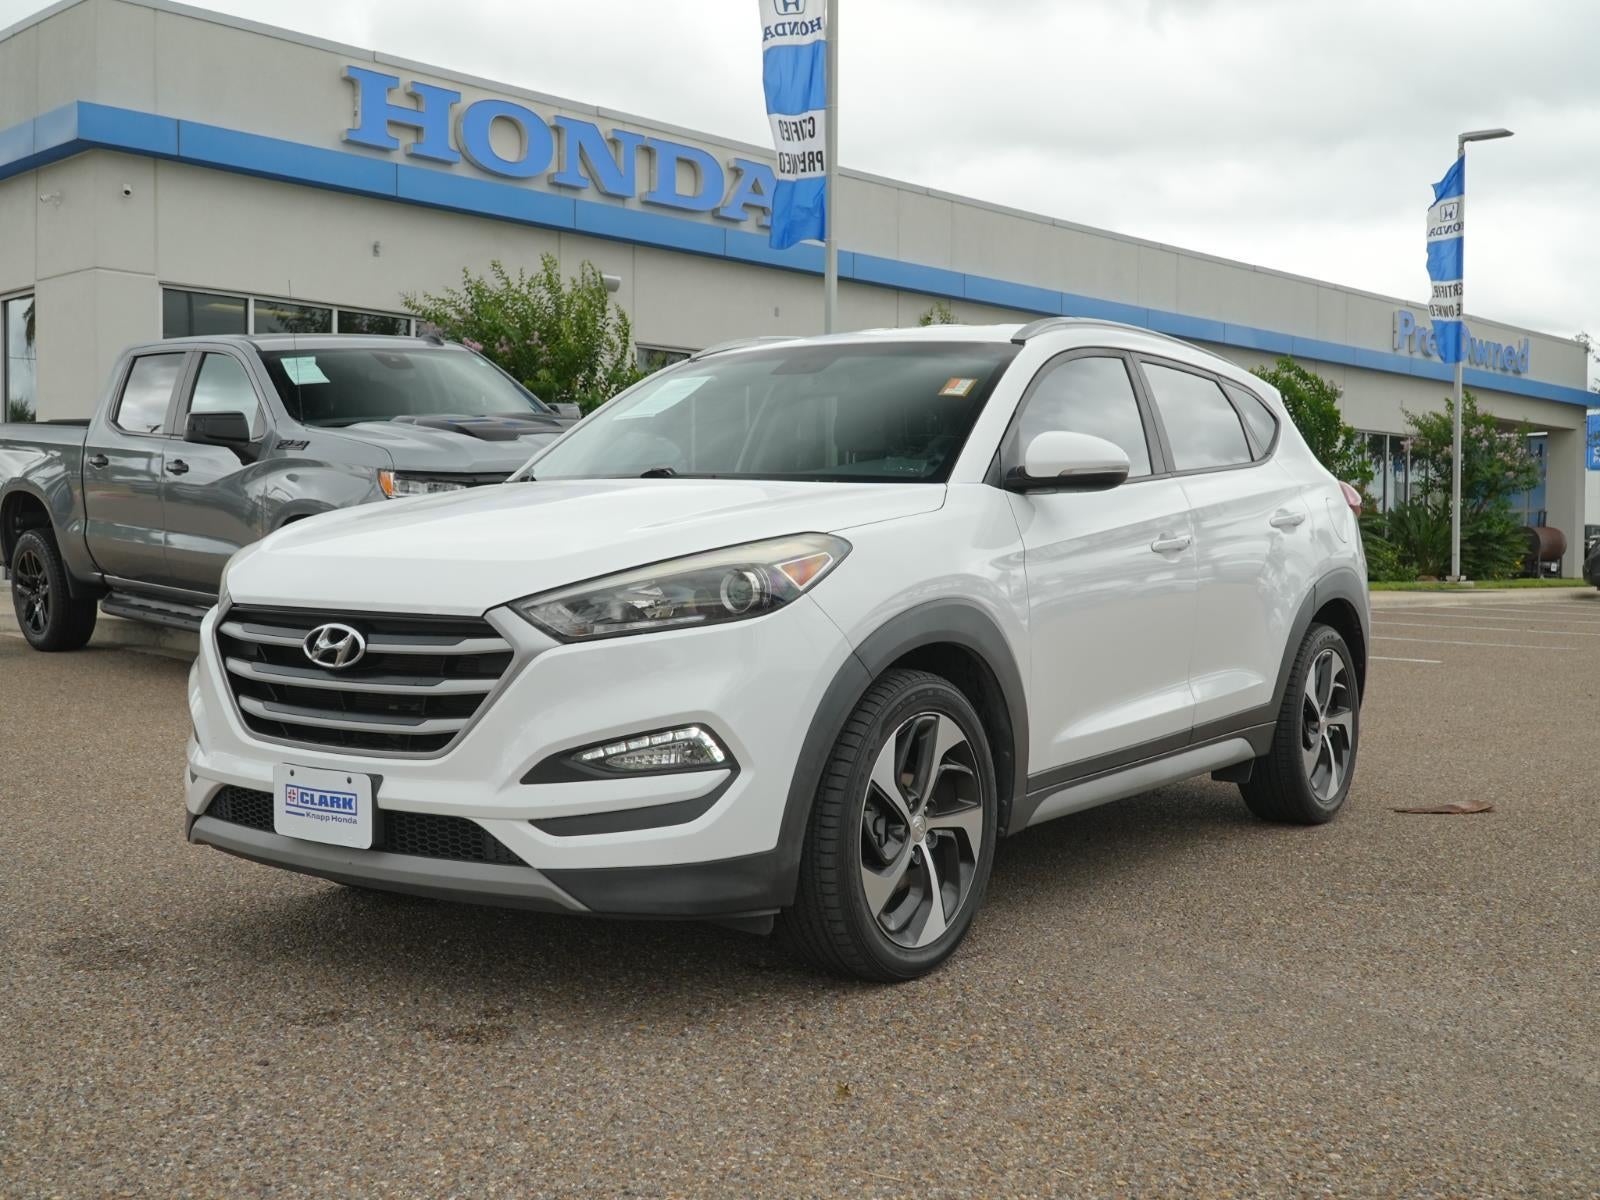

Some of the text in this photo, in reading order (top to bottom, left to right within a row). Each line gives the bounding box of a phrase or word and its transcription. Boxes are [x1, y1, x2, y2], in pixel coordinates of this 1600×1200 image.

[342, 65, 776, 229] HONDA
[300, 791, 353, 810] CLARK
[305, 811, 358, 825] Knapp Honda
